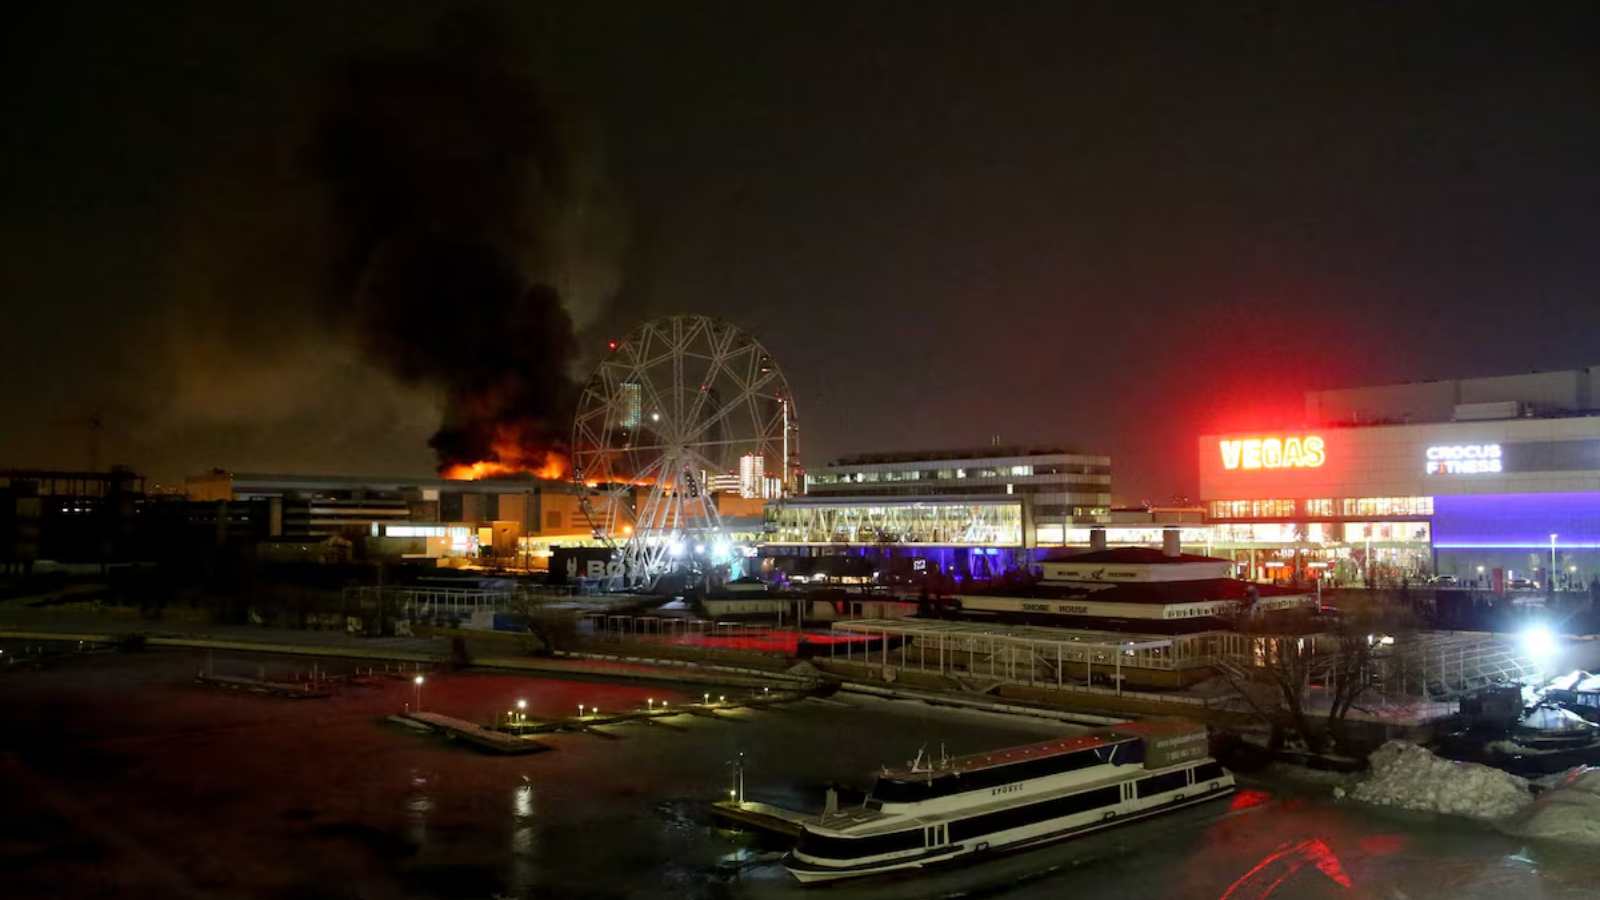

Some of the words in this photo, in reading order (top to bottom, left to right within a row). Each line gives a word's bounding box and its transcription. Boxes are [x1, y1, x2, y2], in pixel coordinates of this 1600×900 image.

[1220, 436, 1325, 469] VEGAS
[1426, 445, 1502, 460] CROCUS
[1426, 460, 1502, 475] FITNESS
